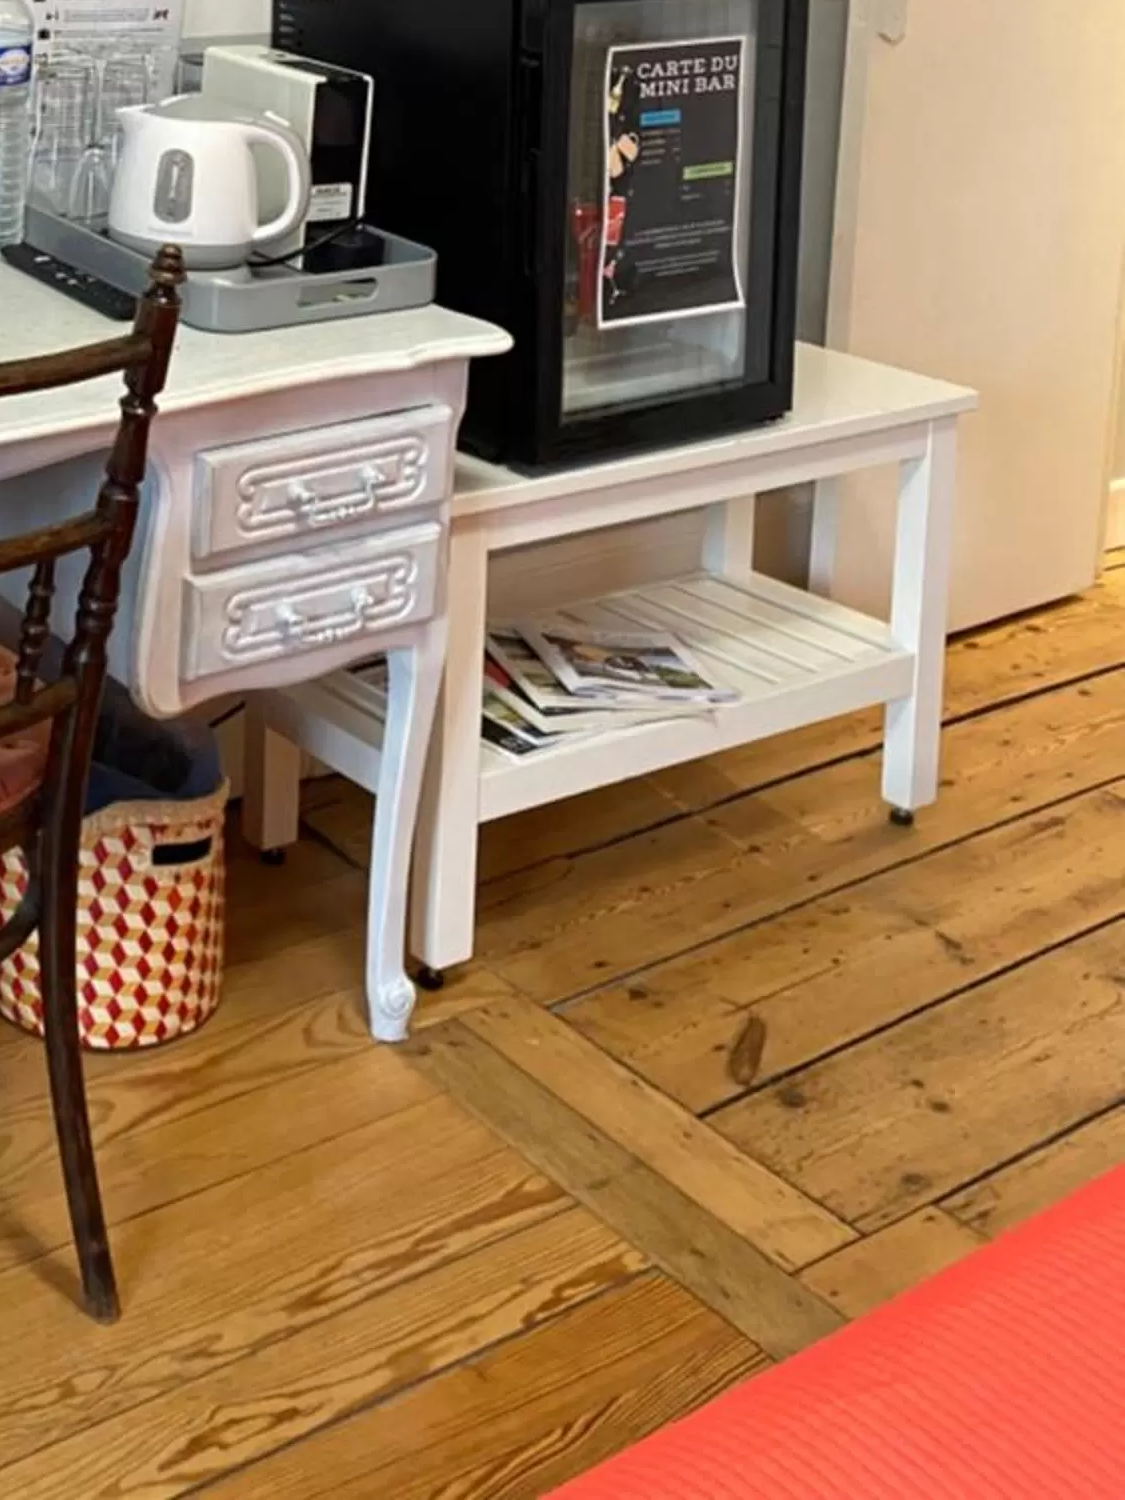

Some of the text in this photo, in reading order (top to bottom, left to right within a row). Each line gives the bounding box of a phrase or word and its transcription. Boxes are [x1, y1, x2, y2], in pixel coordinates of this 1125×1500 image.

[636, 54, 738, 80] CARTE DU
[639, 73, 736, 99] MINI BAR
